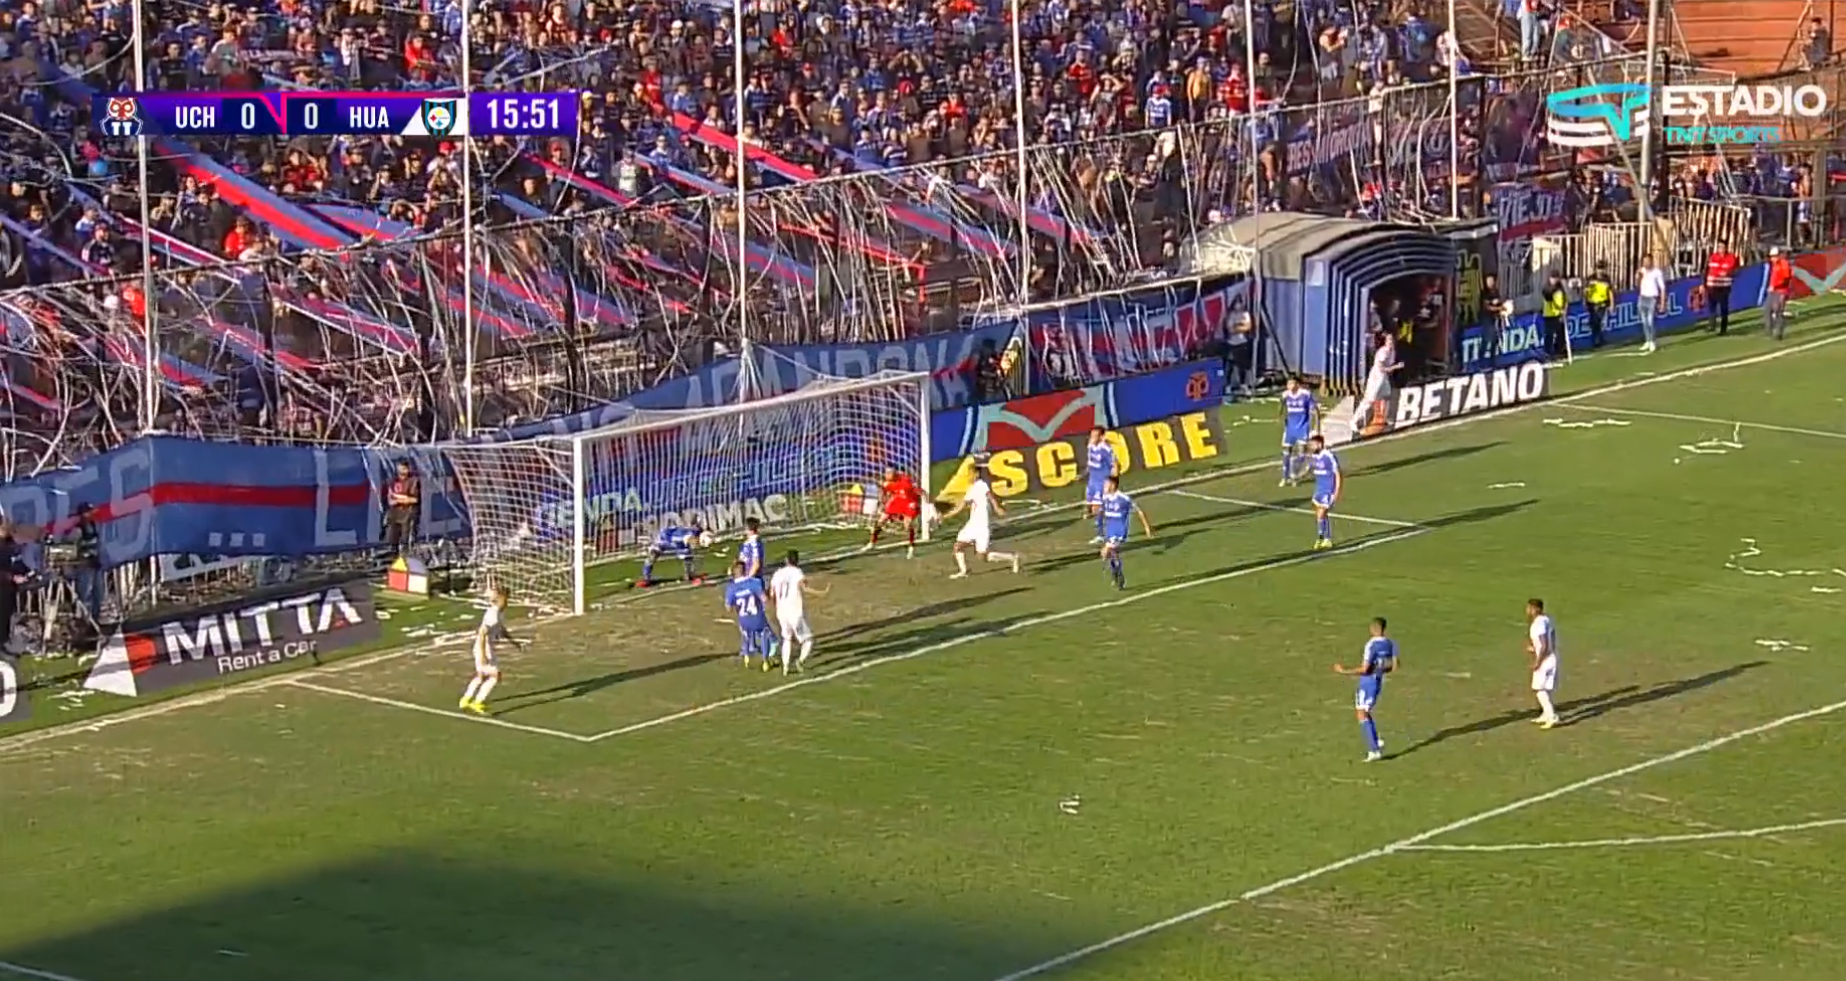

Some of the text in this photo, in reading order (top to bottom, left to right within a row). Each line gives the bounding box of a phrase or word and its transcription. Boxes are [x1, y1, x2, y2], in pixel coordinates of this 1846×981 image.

[1394, 359, 1545, 430] BETANO
[987, 411, 1218, 498] SCORE
[162, 588, 363, 666] MITTA
[735, 595, 758, 617] 24
[217, 638, 318, 675] Rent a Car
